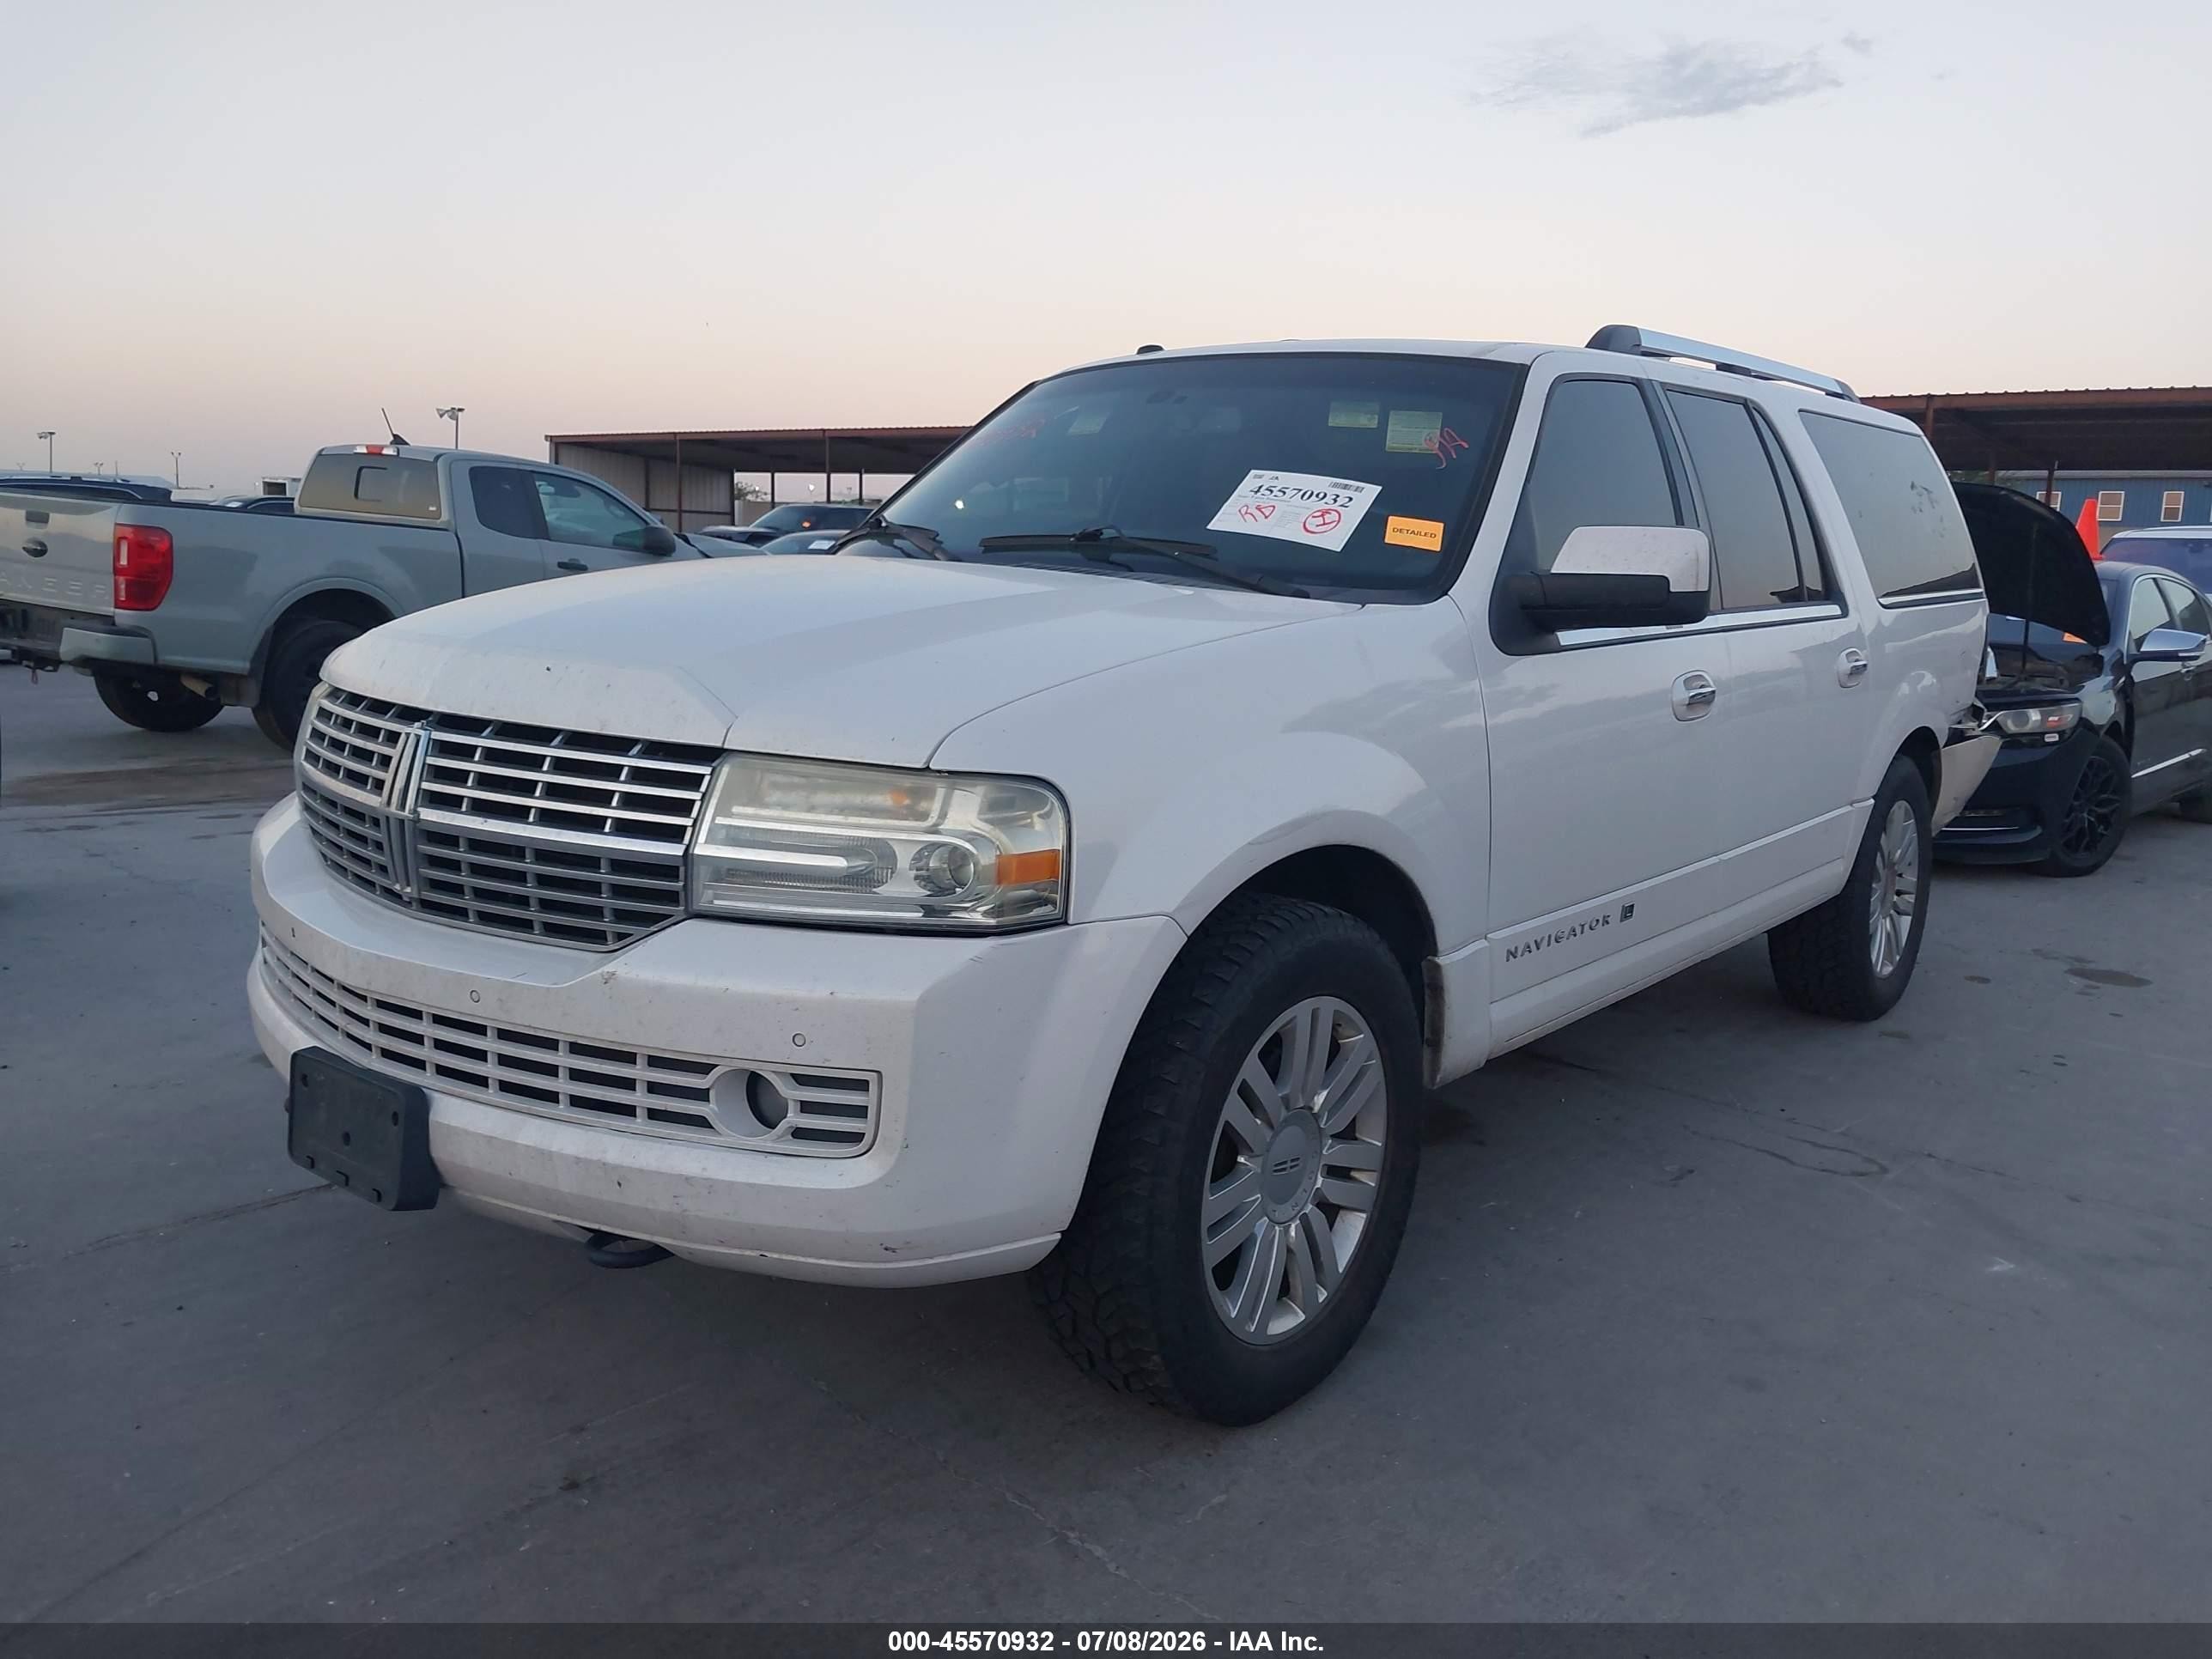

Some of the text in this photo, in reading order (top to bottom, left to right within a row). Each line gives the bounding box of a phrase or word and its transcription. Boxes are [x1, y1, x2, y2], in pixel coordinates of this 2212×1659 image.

[1249, 483, 1354, 508] 45570932
[1391, 526, 1437, 539] DETAILED
[1505, 914, 1612, 963] NAVIGATOR
